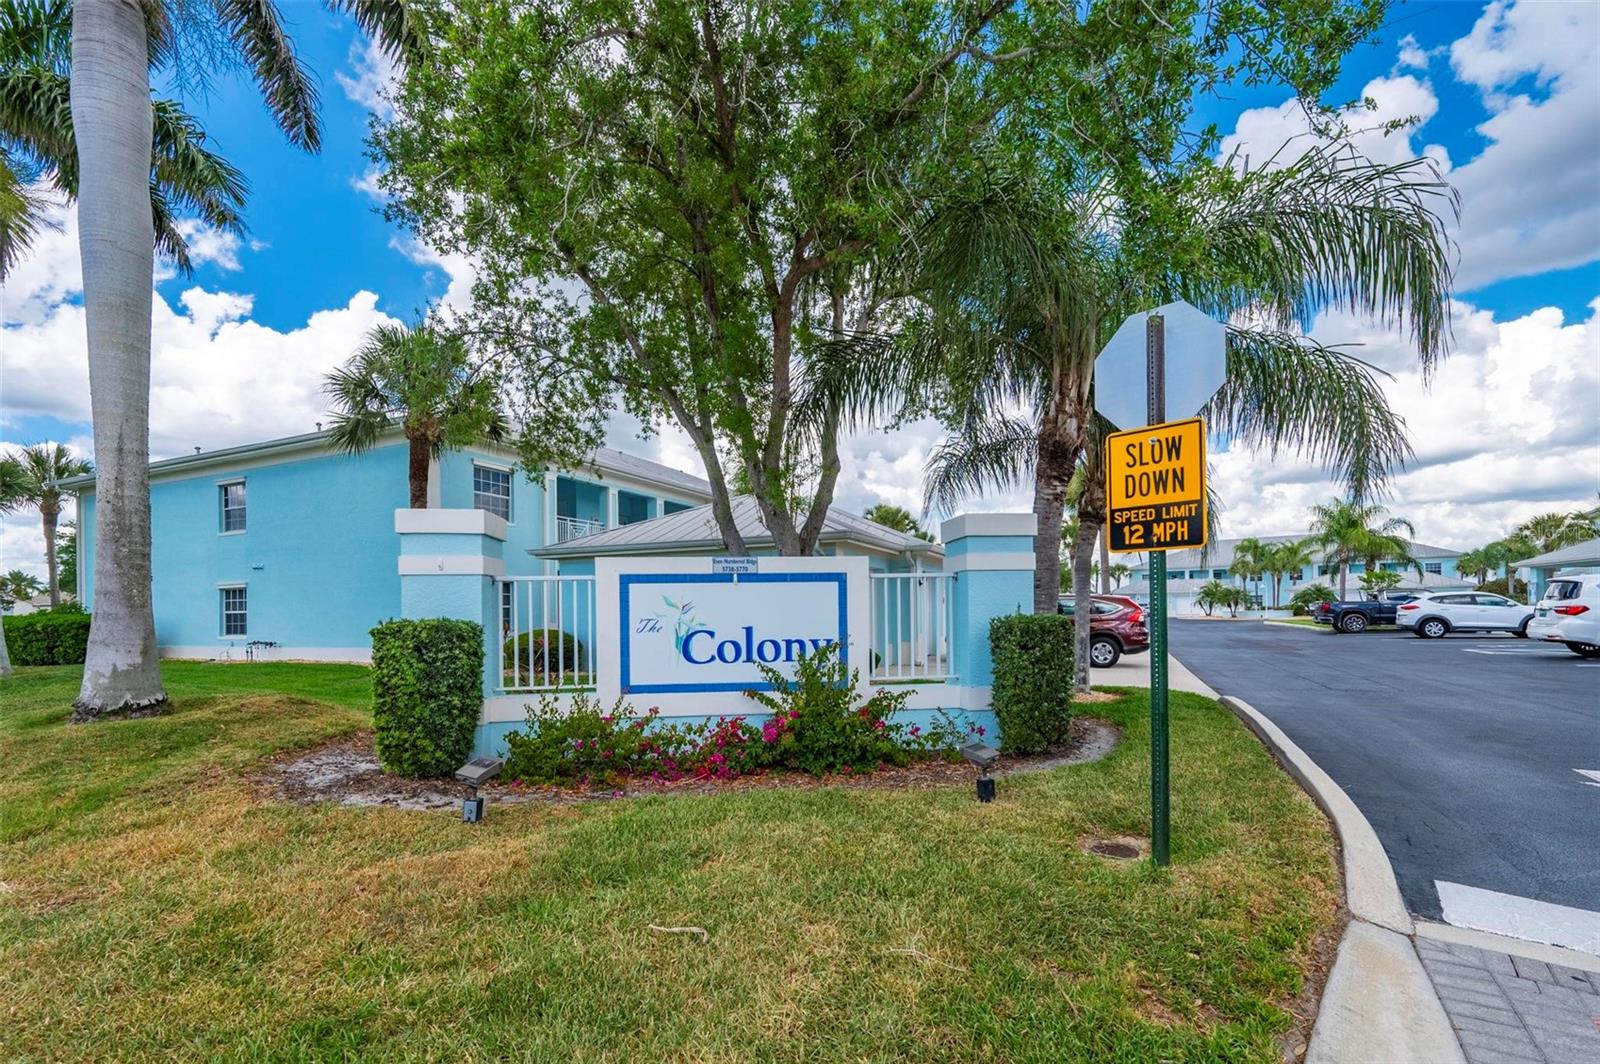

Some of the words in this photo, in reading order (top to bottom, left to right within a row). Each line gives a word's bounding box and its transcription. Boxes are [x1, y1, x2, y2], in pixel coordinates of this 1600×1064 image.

[1125, 434, 1183, 469] SLOW
[1124, 466, 1185, 499] DOWN
[1114, 508, 1156, 524] SPEED
[1162, 503, 1198, 519] LIMIT
[1123, 524, 1145, 545] 12
[1152, 520, 1189, 543] MPH
[636, 618, 663, 633] The
